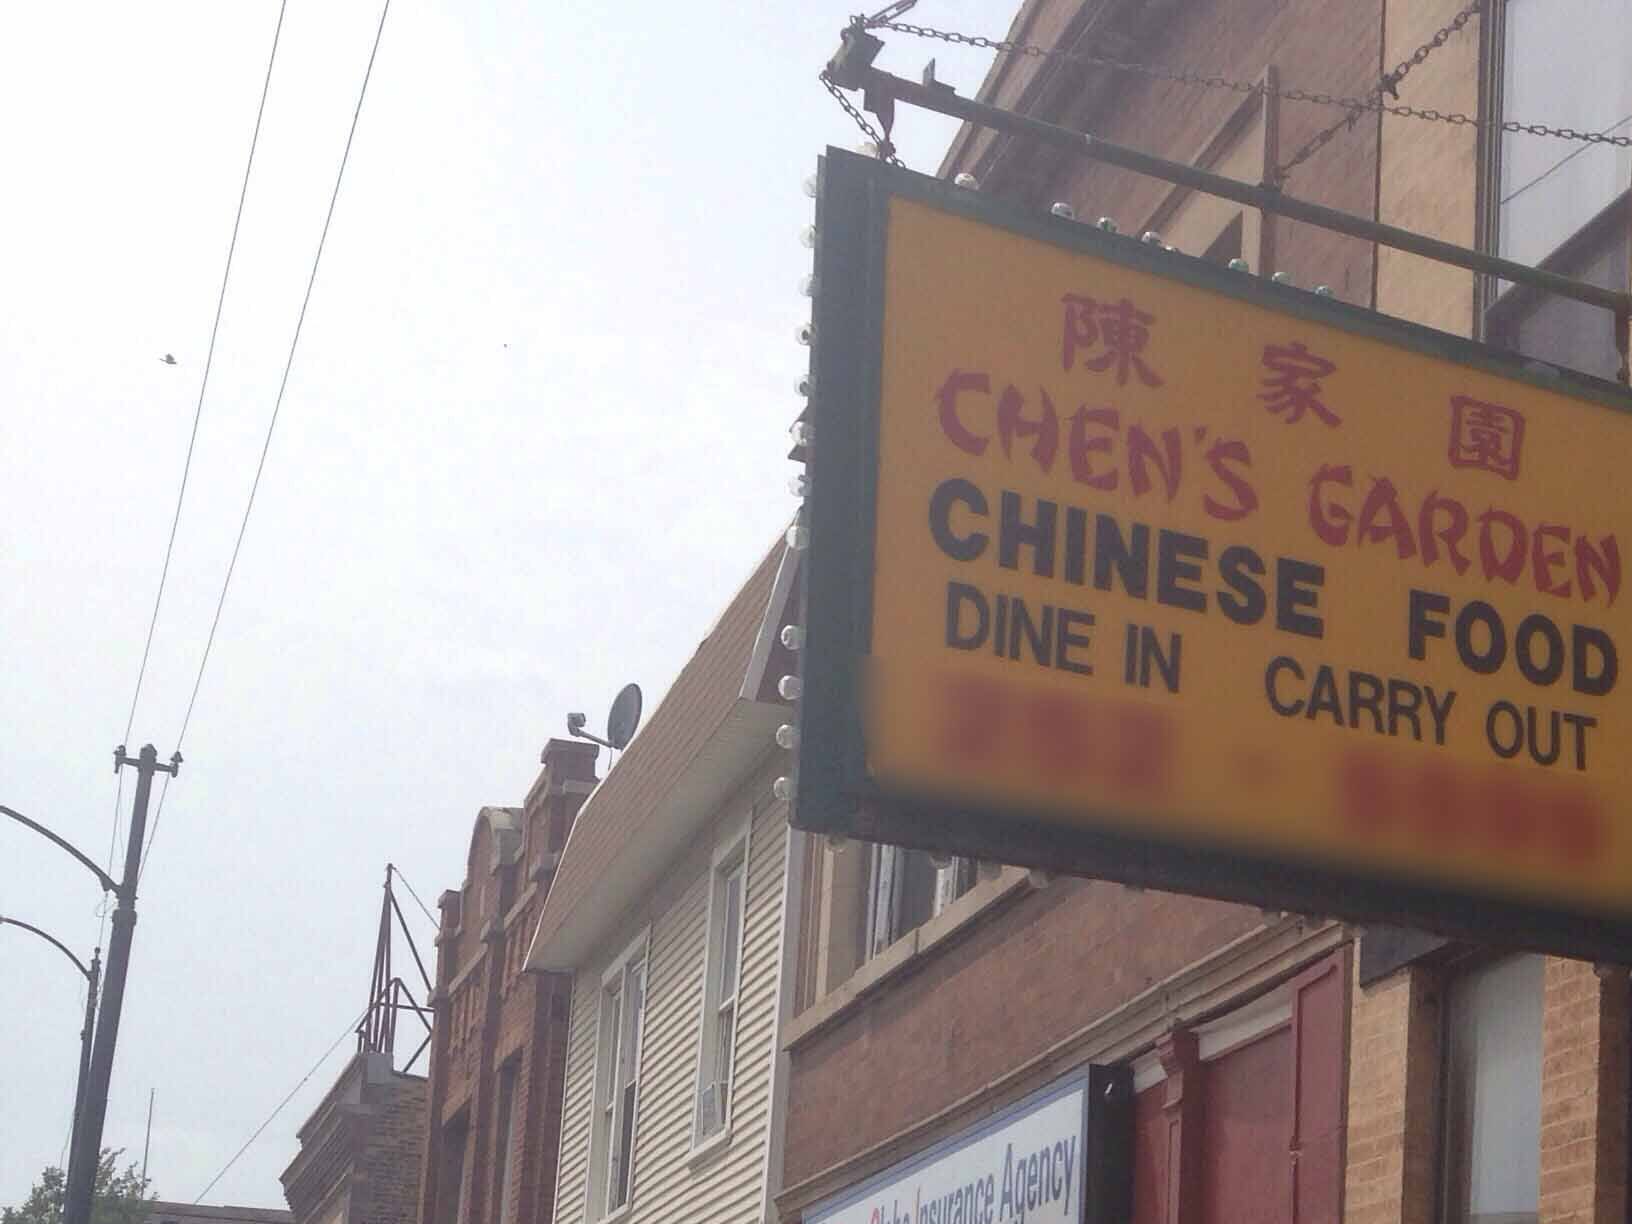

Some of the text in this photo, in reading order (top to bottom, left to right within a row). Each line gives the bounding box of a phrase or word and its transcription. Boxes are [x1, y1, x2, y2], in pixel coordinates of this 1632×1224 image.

[929, 477, 1618, 696] CHINESE FOOD
[938, 369, 1621, 606] CHEN'S GARDEN
[946, 580, 1094, 675] DINE
[1124, 622, 1182, 694] IN
[1265, 655, 1455, 746] CARRY
[1486, 700, 1598, 771] OUT
